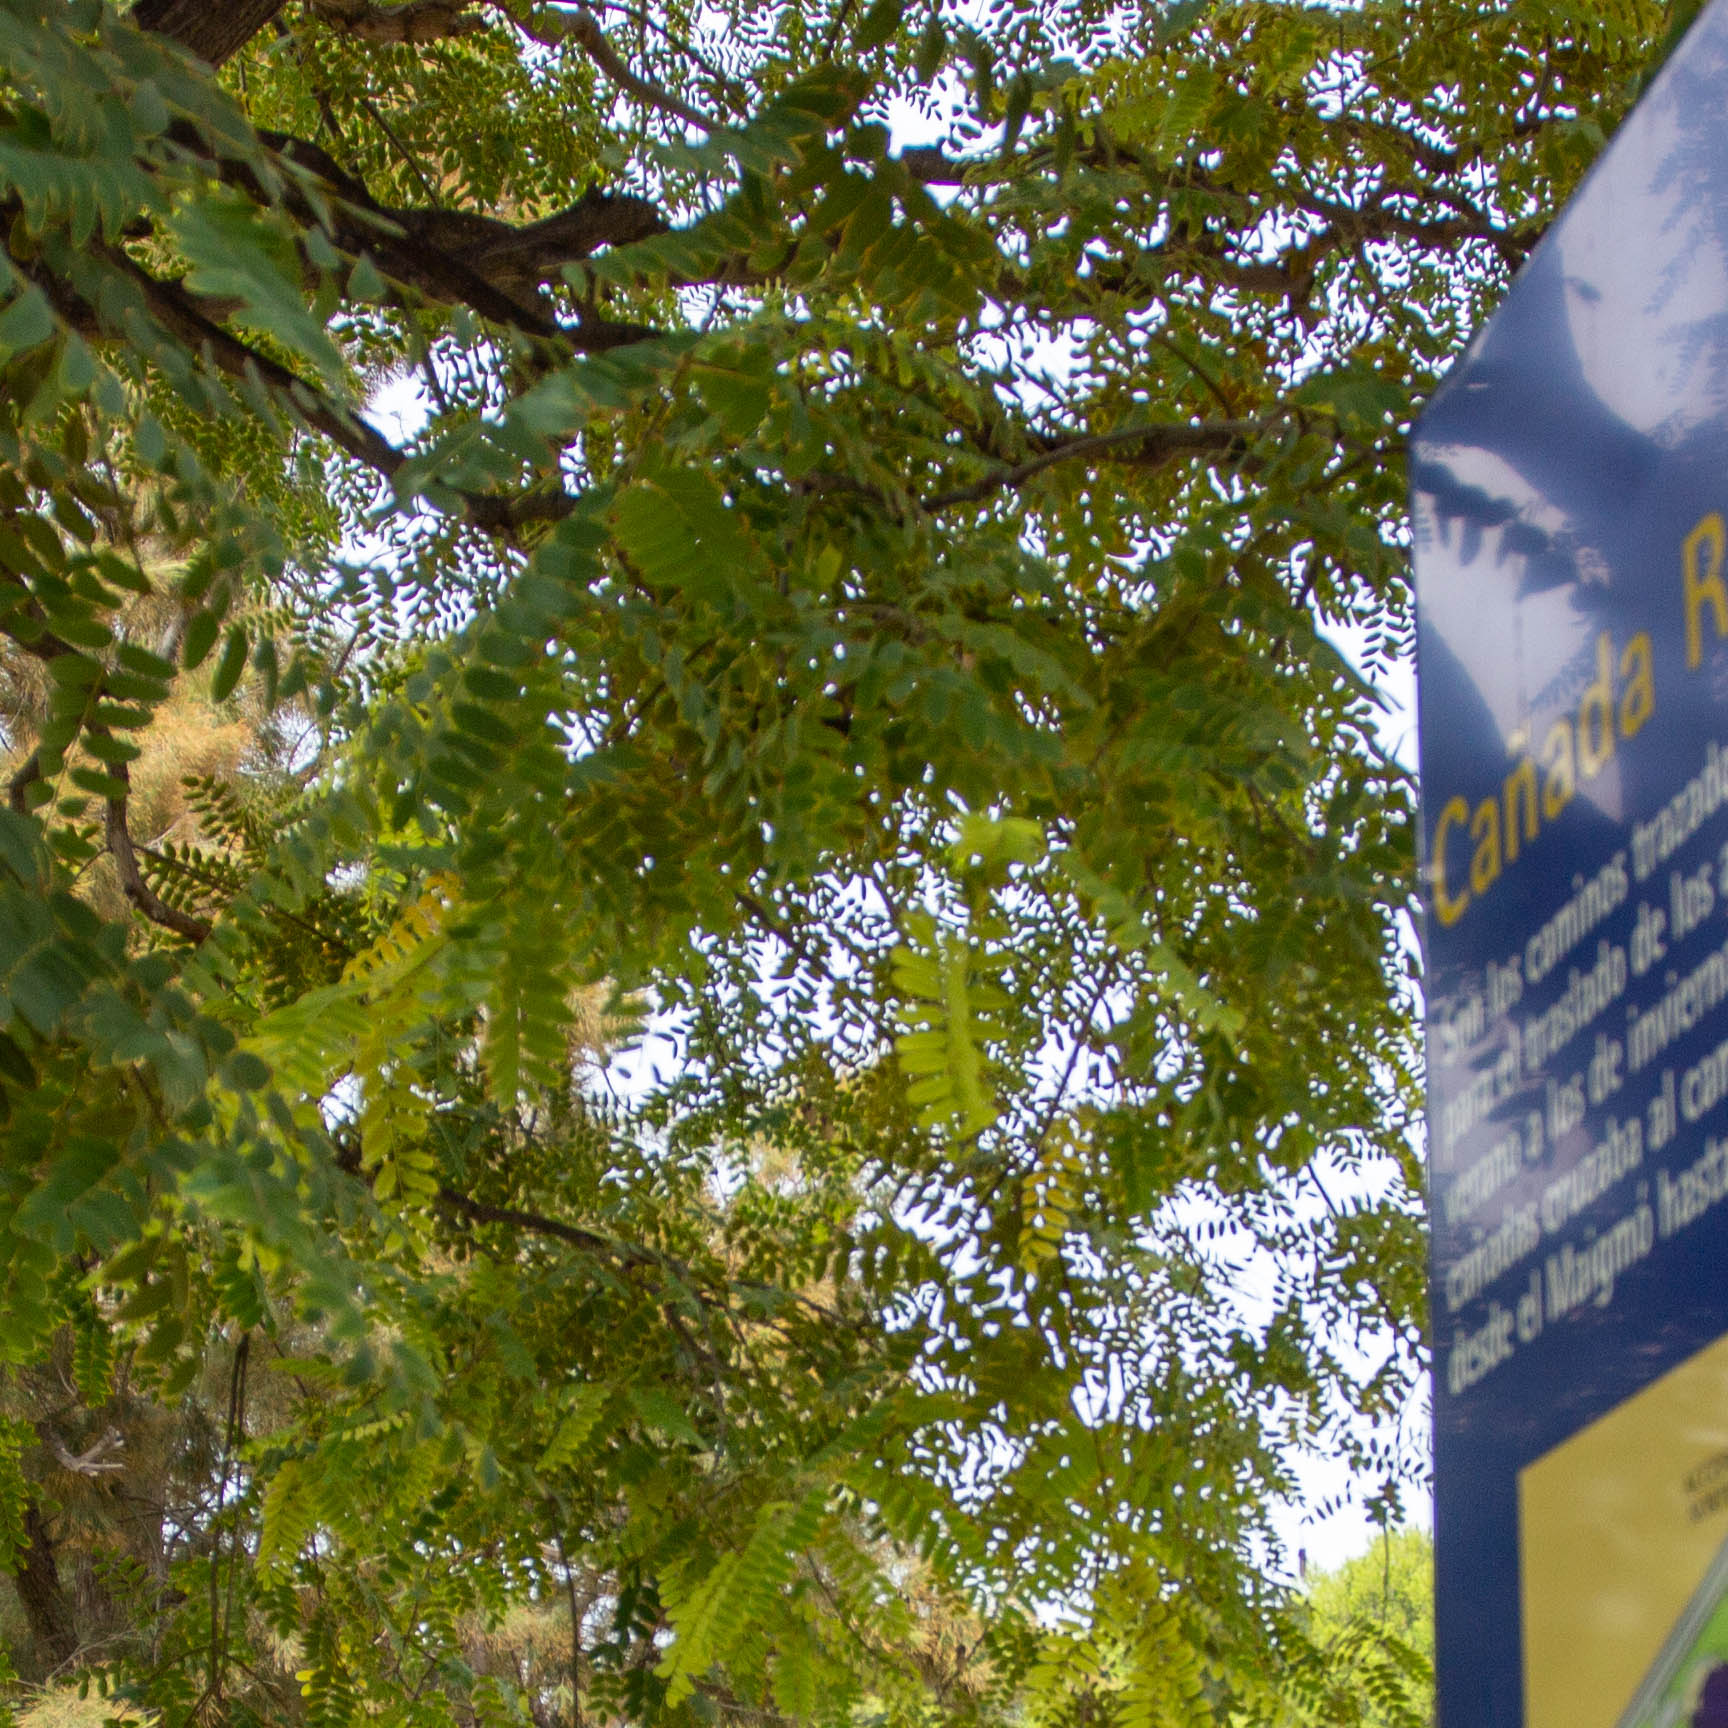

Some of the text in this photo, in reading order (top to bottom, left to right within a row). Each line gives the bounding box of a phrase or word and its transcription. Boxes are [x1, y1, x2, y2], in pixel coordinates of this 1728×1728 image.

[1432, 630, 1654, 925] Cañada
[1524, 850, 1628, 983] caminos
[1525, 939, 1627, 1071] traslado
[1630, 901, 1668, 977] de
[1669, 863, 1715, 941] los
[1526, 1109, 1544, 1162] a
[1547, 1073, 1585, 1140] los
[1587, 1033, 1623, 1105] de
[1541, 1114, 1644, 1234] cruzaba
[1648, 1067, 1677, 1152] al
[1447, 1302, 1515, 1396] desde
[1517, 1267, 1544, 1343] el
